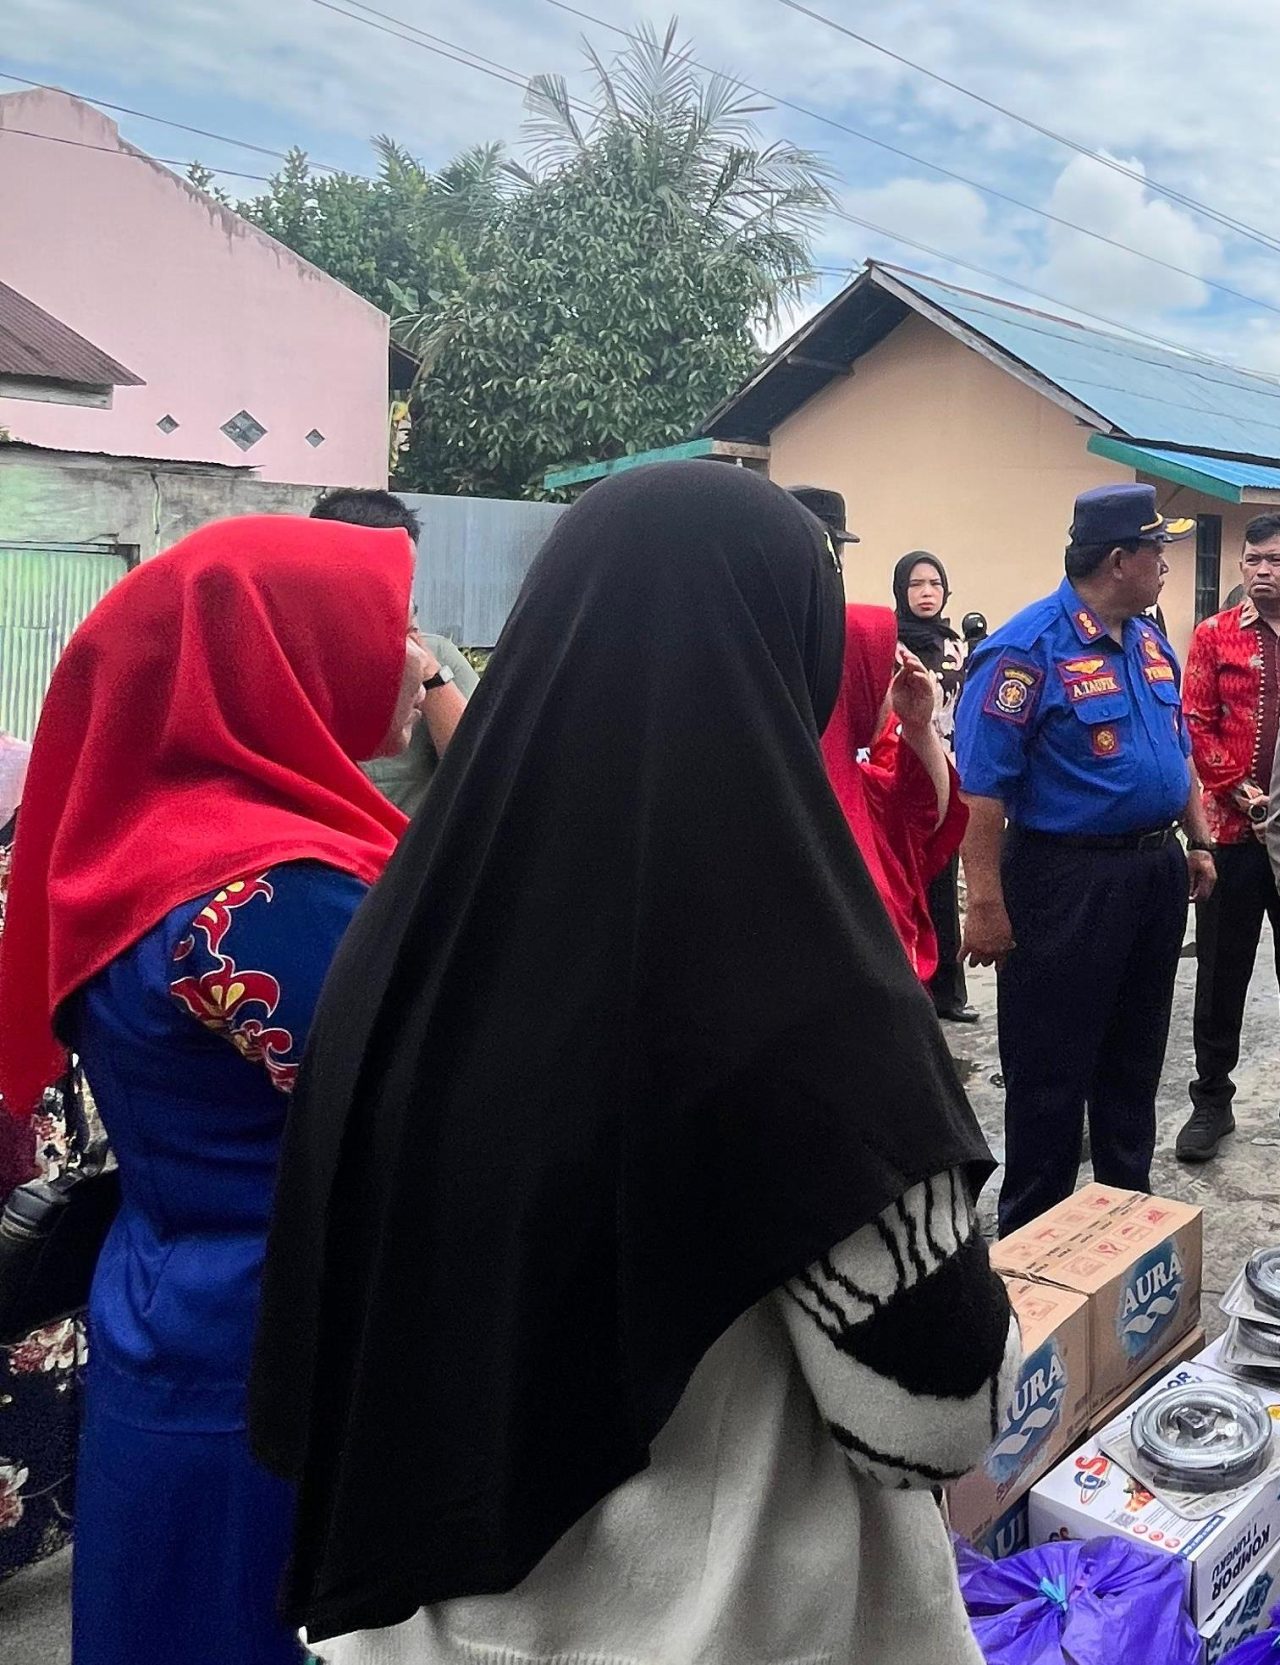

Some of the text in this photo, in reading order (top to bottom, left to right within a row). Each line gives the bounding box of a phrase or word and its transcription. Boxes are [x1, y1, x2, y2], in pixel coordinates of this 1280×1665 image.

[1121, 1252, 1182, 1319] AURA
[1211, 1530, 1251, 1582] TUNGKU
[1212, 1524, 1270, 1600] KOMPOR
